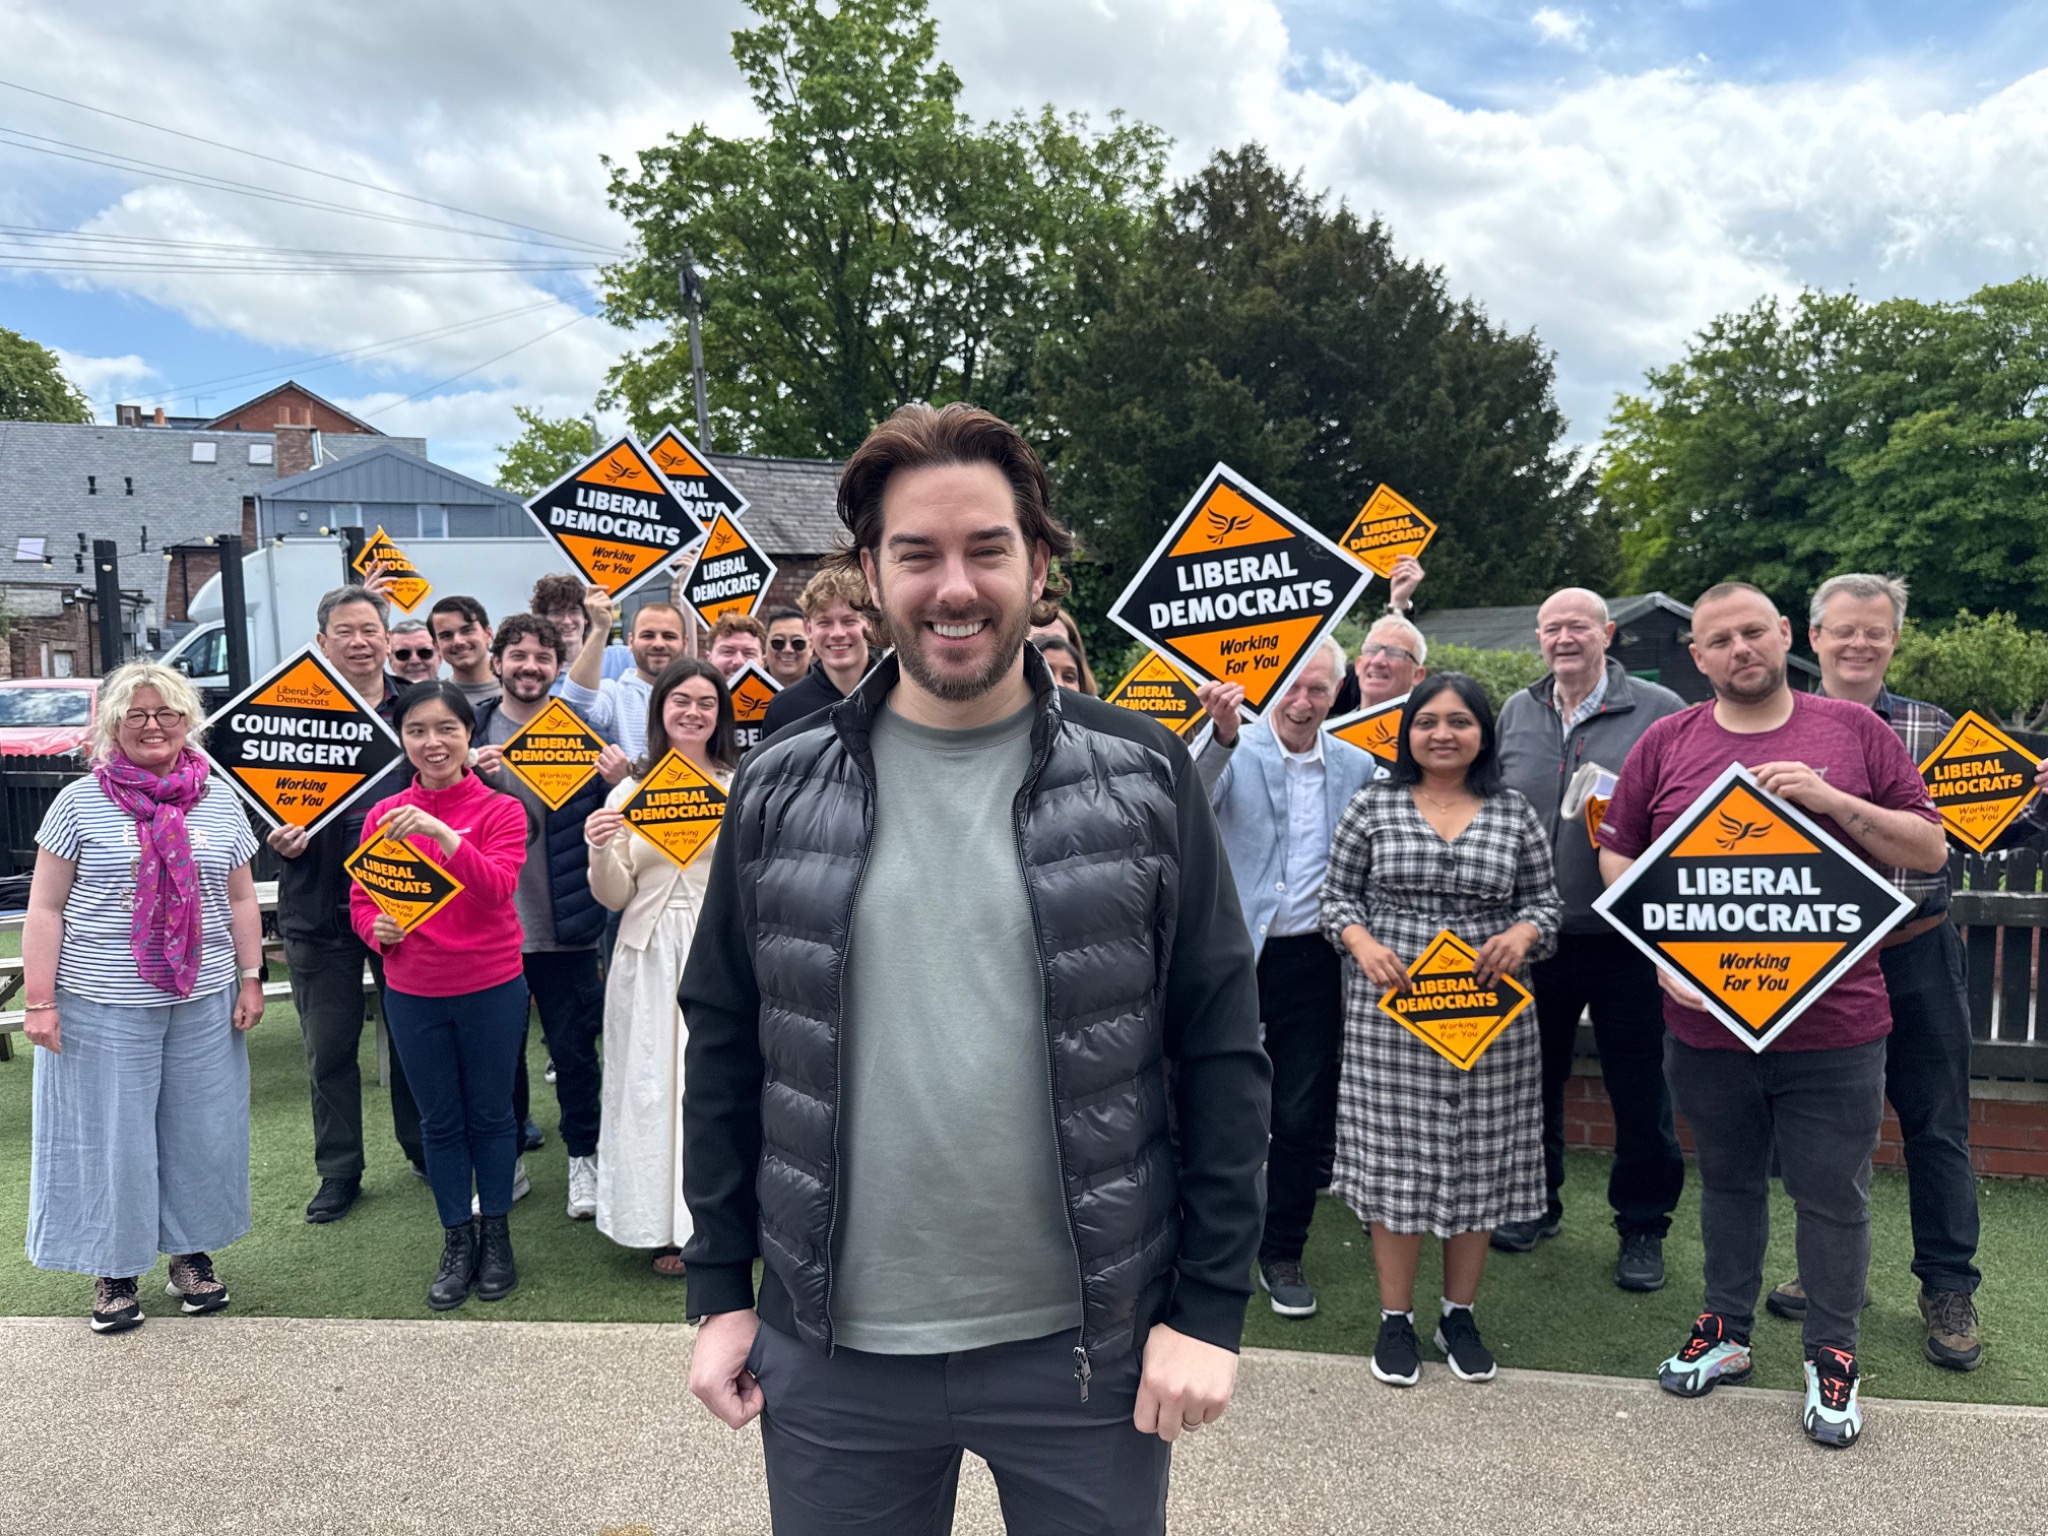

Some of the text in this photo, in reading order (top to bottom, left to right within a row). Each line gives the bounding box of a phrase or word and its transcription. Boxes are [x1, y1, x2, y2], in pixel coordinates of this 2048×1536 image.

[575, 487, 661, 520] LIBERAL
[549, 506, 680, 546] DEMOCRATS
[1362, 517, 1413, 536] LIBERAL
[1350, 526, 1426, 550] DEMOCRATS
[592, 546, 636, 564] Working
[591, 561, 633, 575] For You
[703, 555, 748, 581] LIBERAL
[1176, 551, 1299, 592] LIBERAL
[692, 572, 761, 603] DEMOCRATS
[1149, 579, 1334, 630] DEMOCRATS
[1220, 634, 1279, 656] Working
[1225, 659, 1248, 676] For
[1253, 654, 1280, 671] You
[276, 685, 309, 697] Liberal
[276, 694, 330, 707] Democrats
[1127, 685, 1175, 698] LIBERAL
[230, 713, 374, 742] COUNCILLOR
[241, 739, 362, 766] SURGERY
[526, 737, 585, 749] LIBERAL
[510, 749, 600, 762] DEMOCRATS
[540, 772, 573, 780] Working
[1934, 759, 2005, 781] LIBERAL
[275, 777, 328, 793] Working
[1926, 773, 2023, 798] EMOCRATS
[275, 793, 325, 807] For You
[646, 790, 709, 806] LIBERAL
[630, 802, 726, 821] DEMOCRATS
[1959, 804, 2000, 815] Working
[1960, 813, 1999, 824] For You
[663, 829, 699, 838] Working
[363, 857, 416, 879] LIBERAL
[354, 866, 432, 894] DEMOCRATS
[1677, 867, 1822, 896] LIBERAL
[1642, 903, 1862, 933] DEMOCRATS
[1719, 953, 1791, 972] Working
[1411, 977, 1479, 996] LIBERAL
[1722, 974, 1790, 991] For You
[1396, 992, 1499, 1014] DEMOCRATS
[1438, 1021, 1478, 1030] Working
[1461, 1030, 1478, 1038] You
